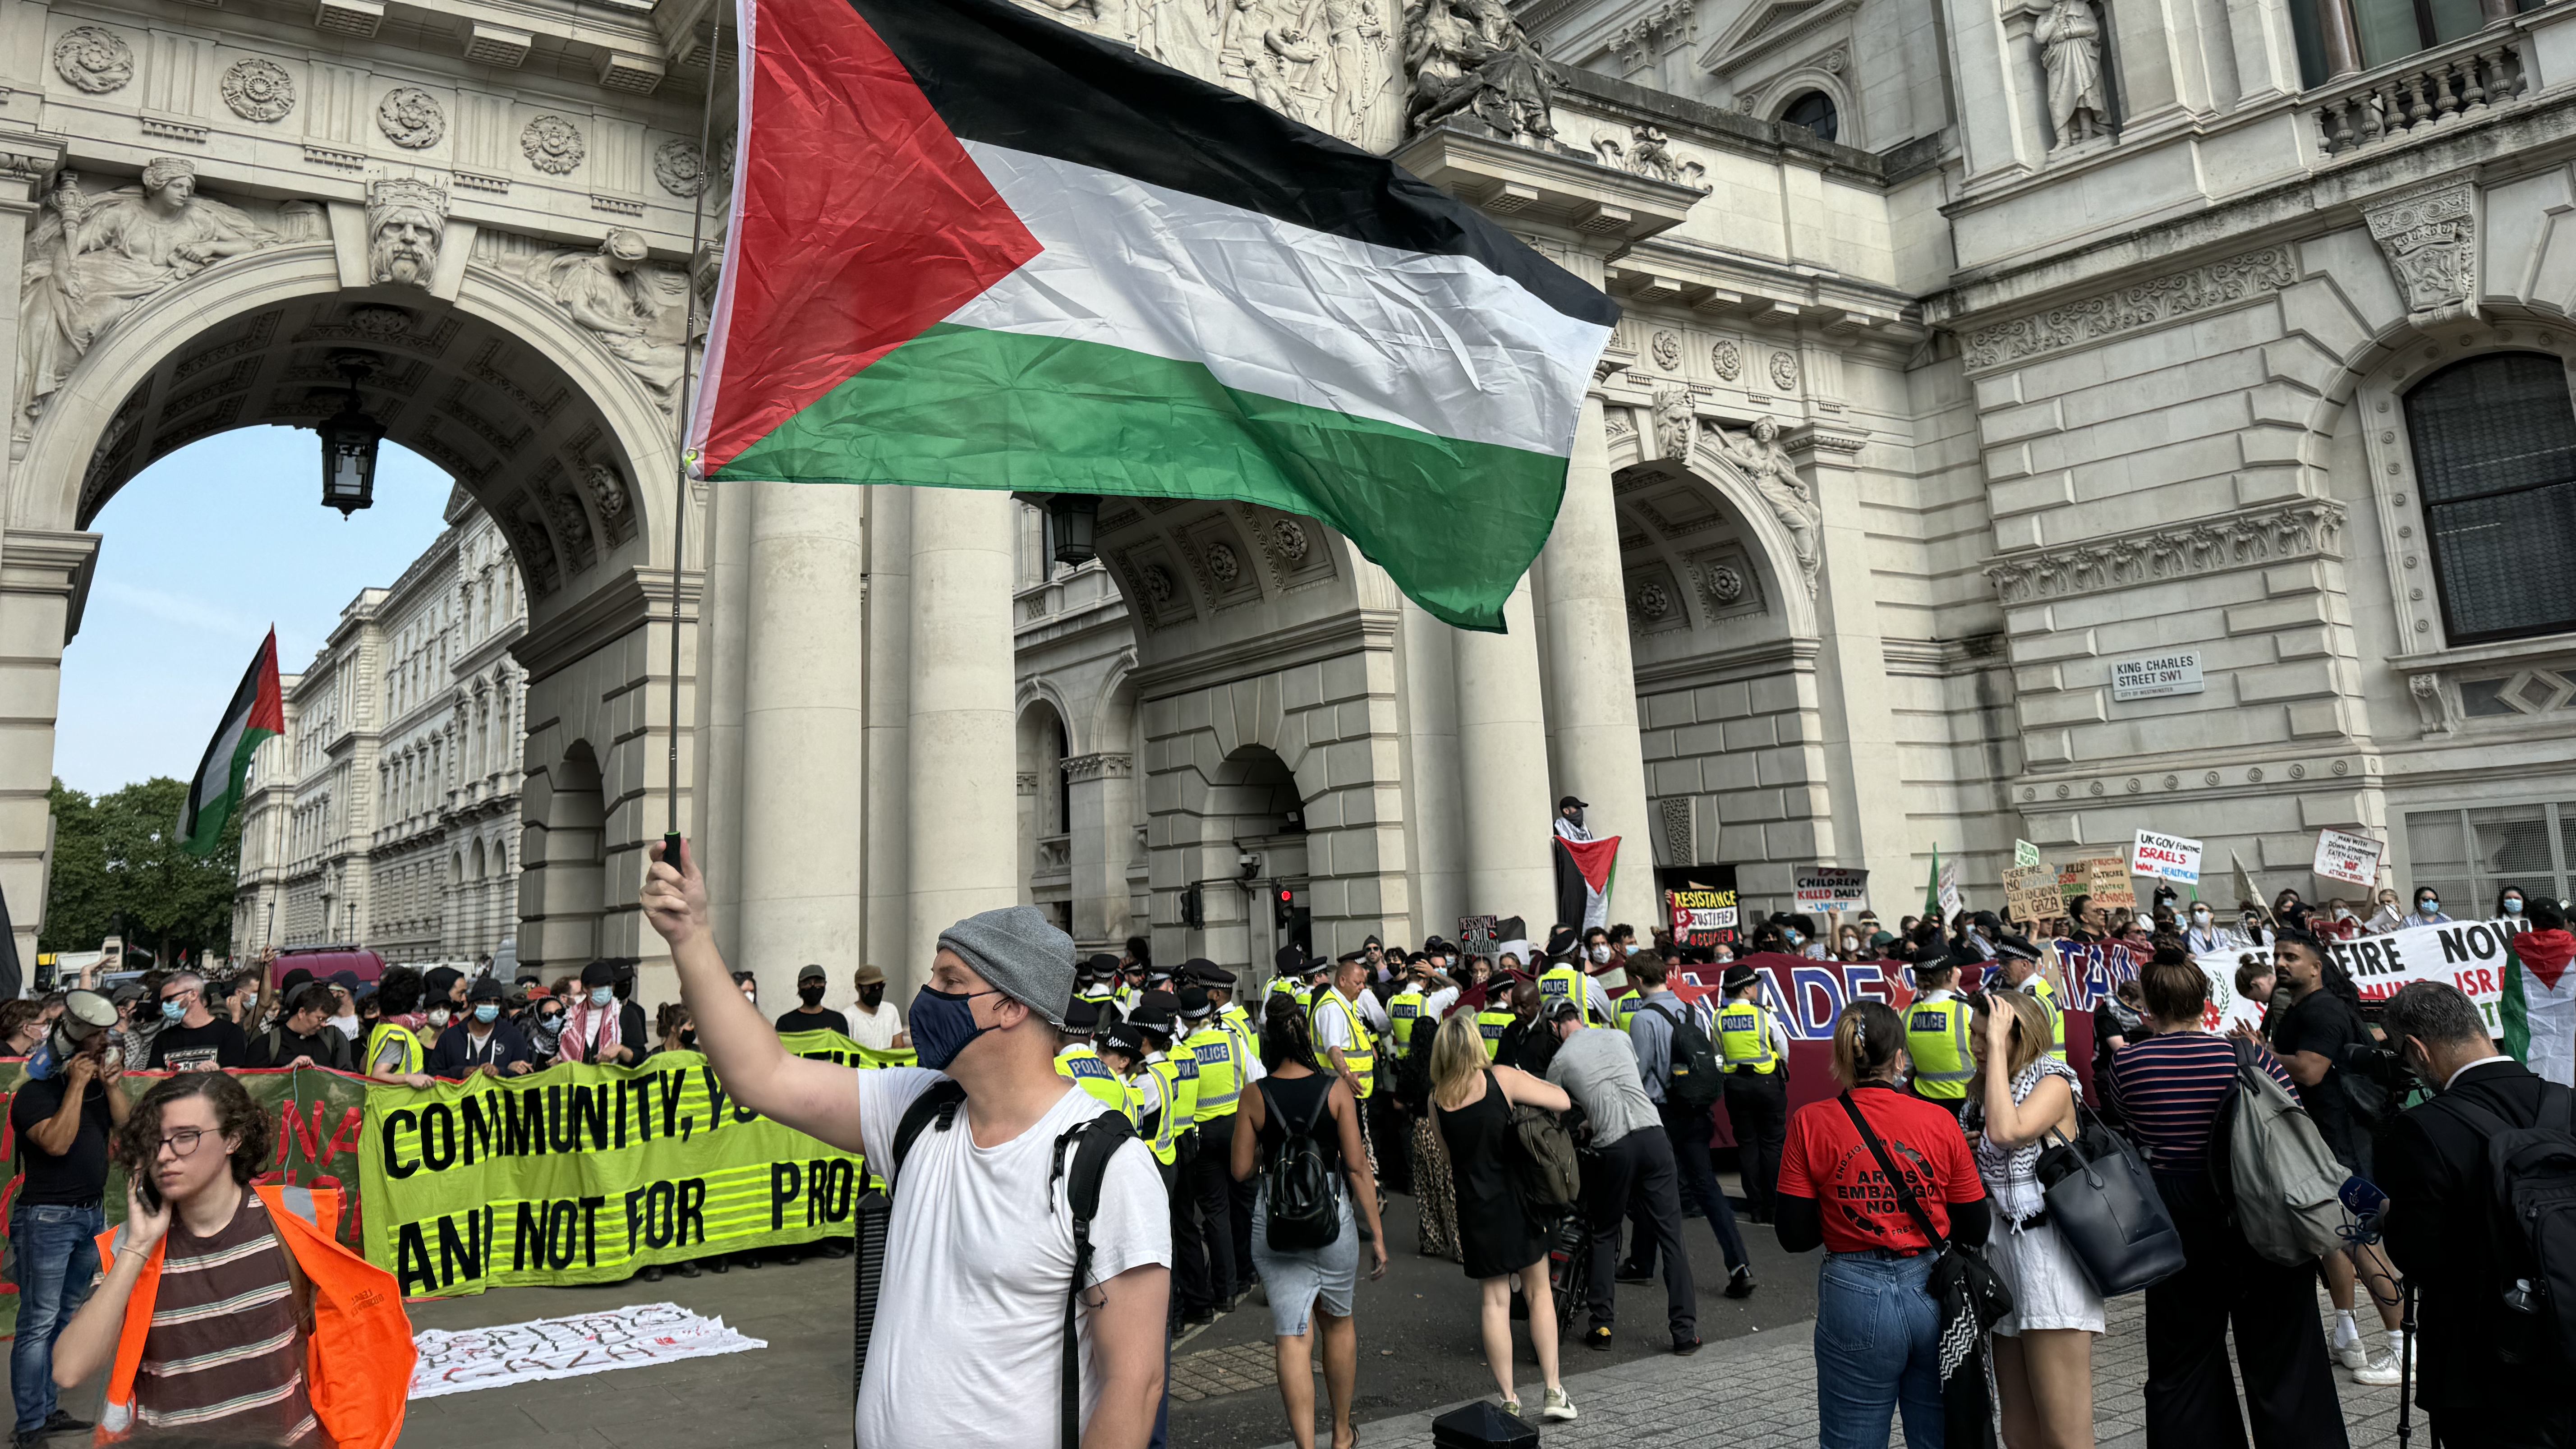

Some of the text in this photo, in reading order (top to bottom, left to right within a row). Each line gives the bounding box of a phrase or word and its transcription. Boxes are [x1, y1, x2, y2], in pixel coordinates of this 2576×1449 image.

[2117, 656, 2193, 674] KING CHARLES
[2119, 670, 2181, 686] STREET SW1
[2140, 687, 2173, 695] WESTMINSTER
[2141, 834, 2155, 844] UK
[2156, 837, 2175, 849] GOV
[2353, 838, 2368, 847] WITH
[2328, 841, 2377, 858] DOWN SYNDROME
[2328, 849, 2362, 862] EATEN ALIVE
[2004, 865, 2042, 879] THERE ARE
[2065, 863, 2084, 874] KILLS
[1798, 878, 1859, 888] CHILDREN
[2006, 879, 2020, 892] NO
[1674, 890, 1737, 908] RESISTANCE
[1797, 888, 1863, 900] KILLED DAILY
[2007, 891, 2024, 902] FULLY
[2093, 891, 2135, 903] GENOCIDE
[2012, 902, 2025, 917] IN
[2031, 897, 2058, 912] GAZA
[1459, 915, 1496, 930] RESISTANCE
[1676, 910, 1734, 926] IS JUSTIFIED
[1468, 928, 1489, 942] UNTIL
[1690, 929, 1734, 947] OCCUPIED
[1541, 981, 1567, 992] POLICE
[1621, 998, 1642, 1011] POLIC
[1393, 1006, 1416, 1018] POLICE
[1722, 1017, 1754, 1030] POLICE
[1912, 1014, 1945, 1029] POLICE
[1196, 1046, 1228, 1062] OLICE
[382, 1068, 693, 1179] COMMUNITY,
[1835, 1139, 1887, 1180] END ZIONM
[1857, 1170, 1918, 1184] ARS
[1836, 1184, 1935, 1200] EMBAGO
[513, 1195, 605, 1270] NOT
[625, 1178, 706, 1256] FOR
[1891, 1224, 1915, 1236] FREE
